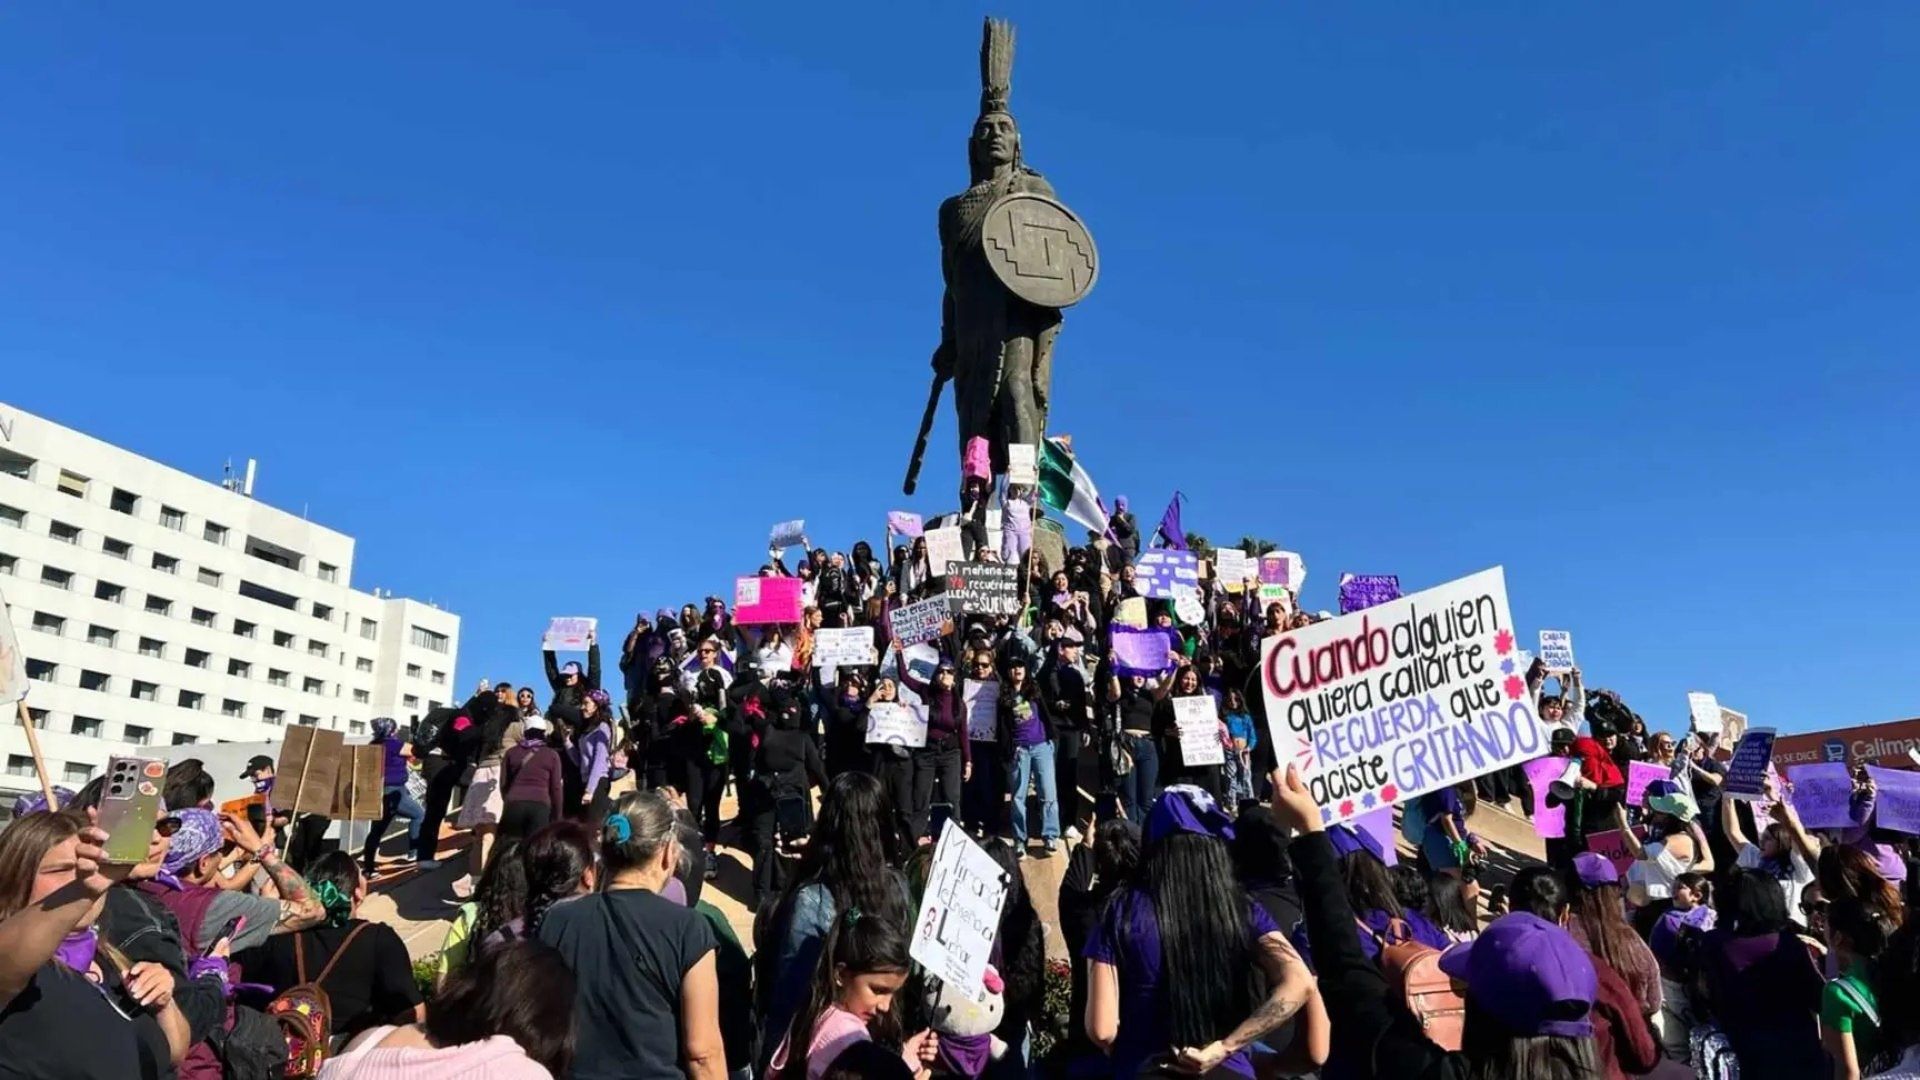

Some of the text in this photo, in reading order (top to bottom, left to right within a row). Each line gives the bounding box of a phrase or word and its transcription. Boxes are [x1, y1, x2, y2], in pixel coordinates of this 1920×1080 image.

[946, 590, 978, 599] LLENA
[948, 562, 959, 575] Si
[1265, 615, 1389, 698] Cuando
[1391, 594, 1498, 660] alguien
[1288, 677, 1373, 743] quiera
[1379, 642, 1486, 702] callarte
[1302, 702, 1540, 806] aciste GRITANDO
[1313, 679, 1500, 768] RECUERDA que
